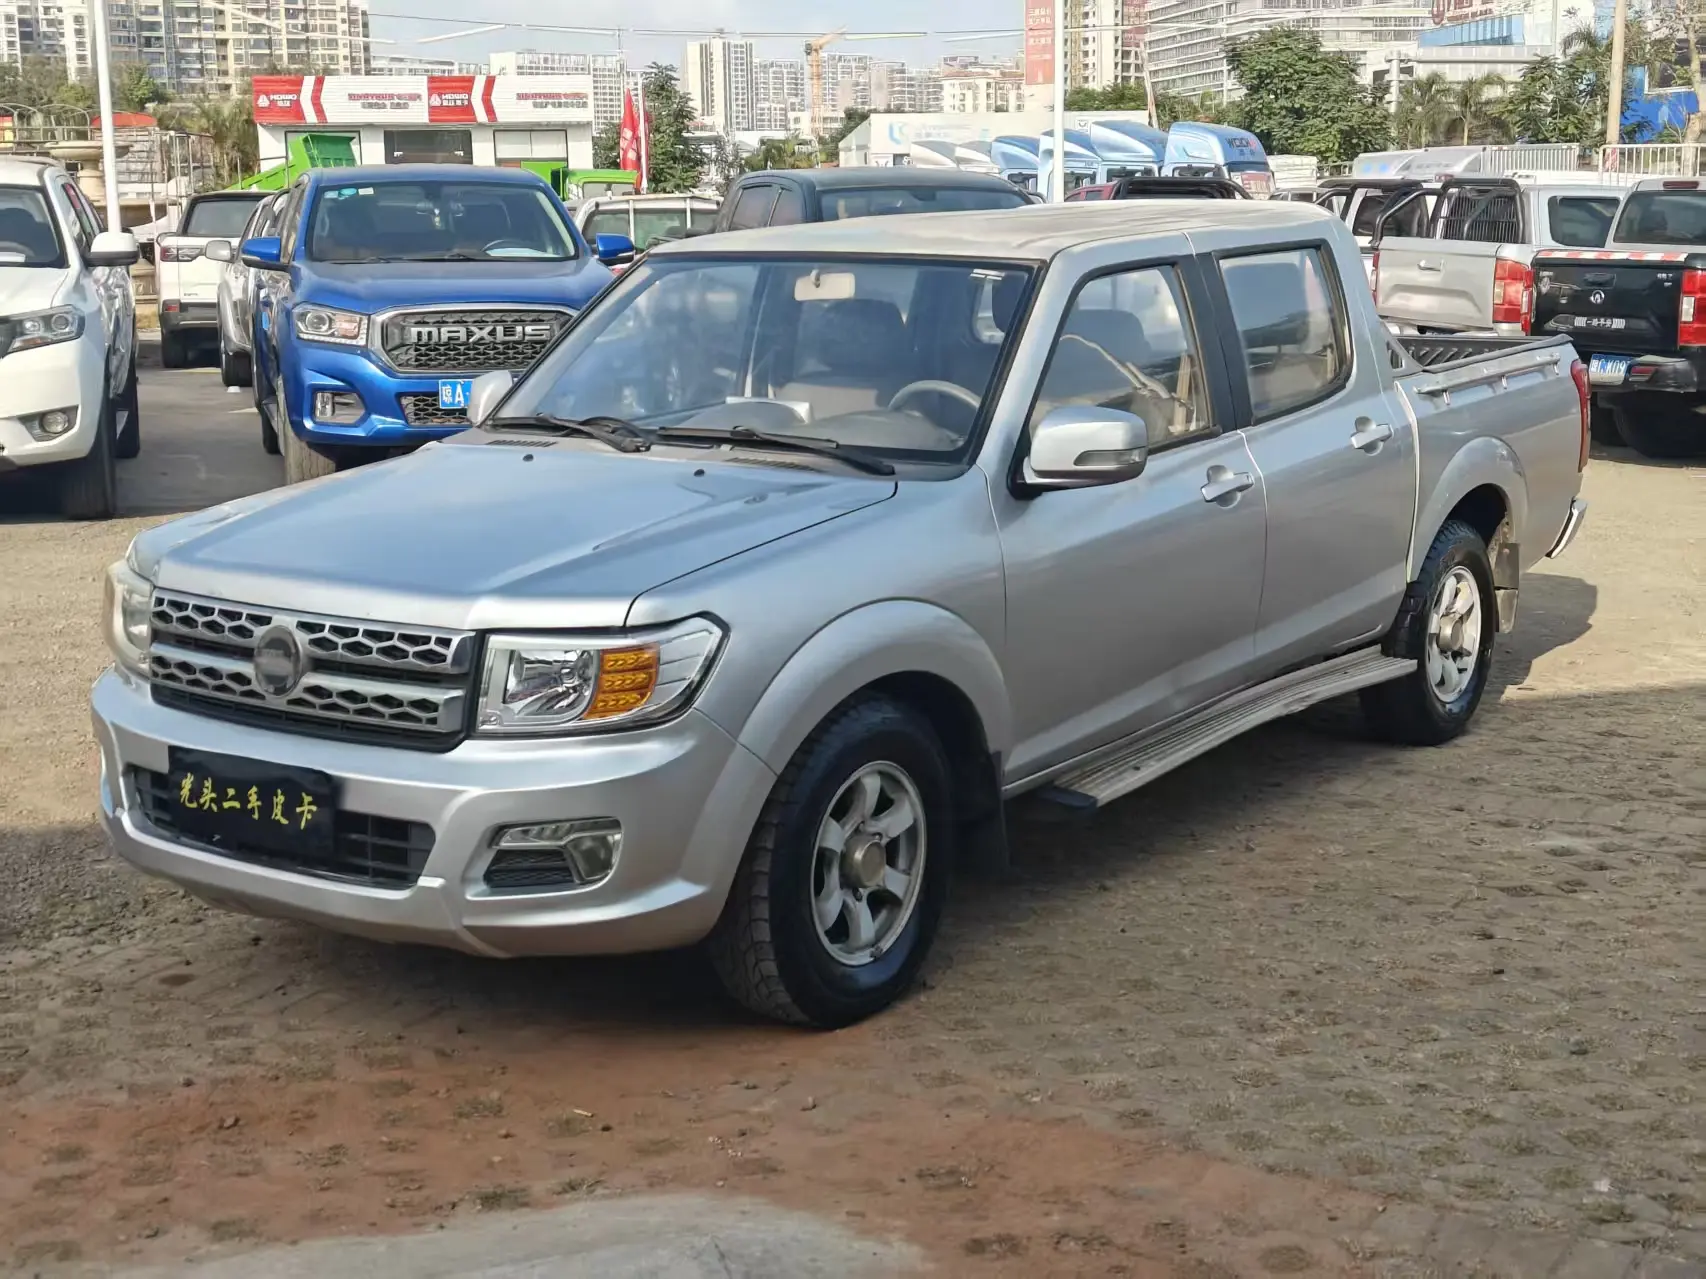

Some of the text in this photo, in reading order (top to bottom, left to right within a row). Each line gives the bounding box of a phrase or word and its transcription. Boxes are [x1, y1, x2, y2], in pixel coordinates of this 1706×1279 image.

[410, 325, 550, 343] MAXUS
[180, 772, 318, 830] 光头二手皮卡
